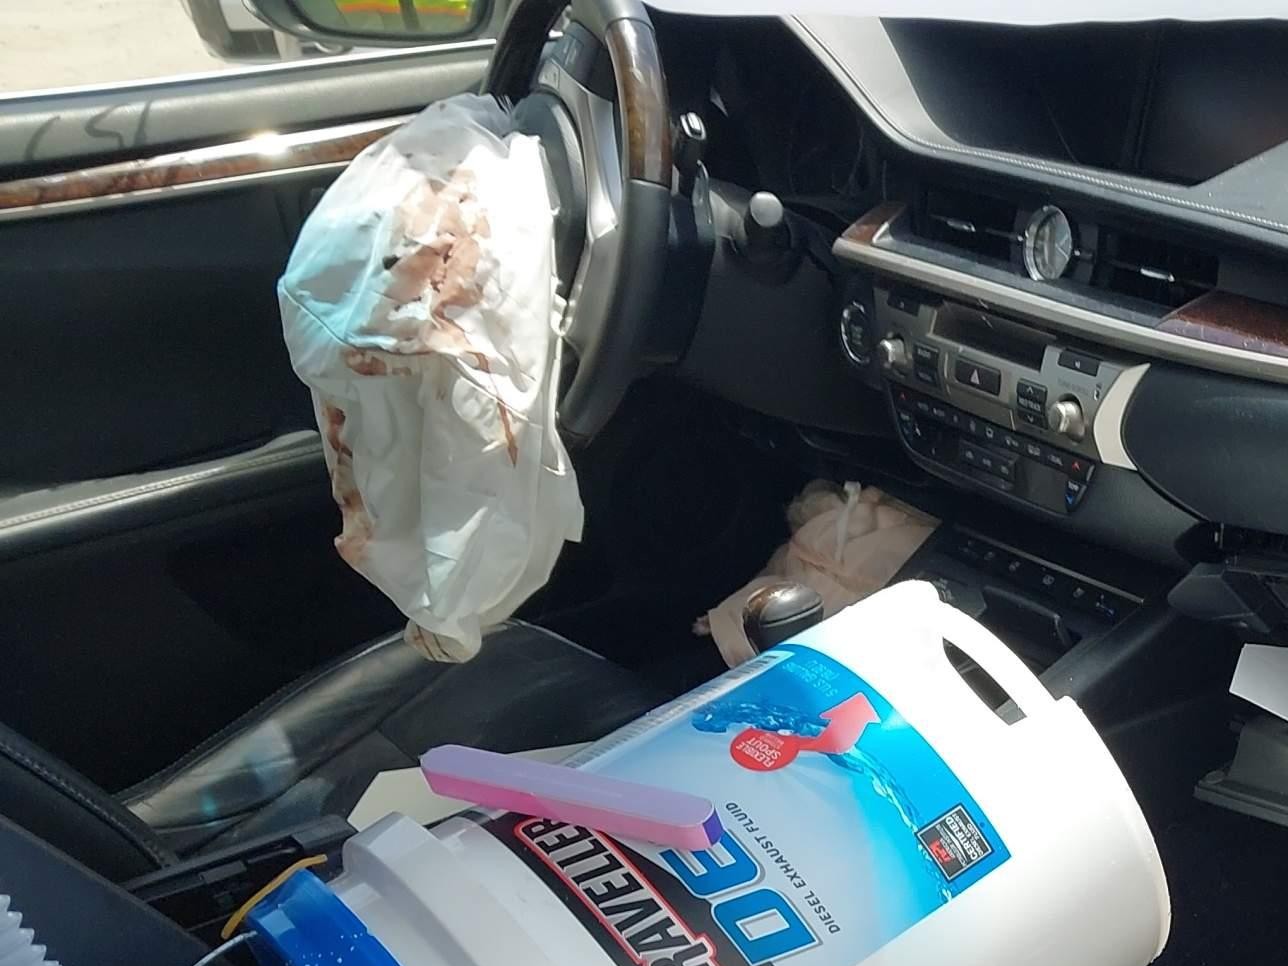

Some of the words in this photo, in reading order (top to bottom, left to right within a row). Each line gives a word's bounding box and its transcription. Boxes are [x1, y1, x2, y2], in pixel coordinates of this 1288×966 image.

[736, 742, 775, 767] FLEXIBLE
[747, 737, 782, 760] SPOUT
[725, 800, 760, 833] FLUID
[946, 816, 978, 860] CERTIFIED
[754, 834, 805, 888] EXHAUST
[804, 890, 841, 935] DIESEL
